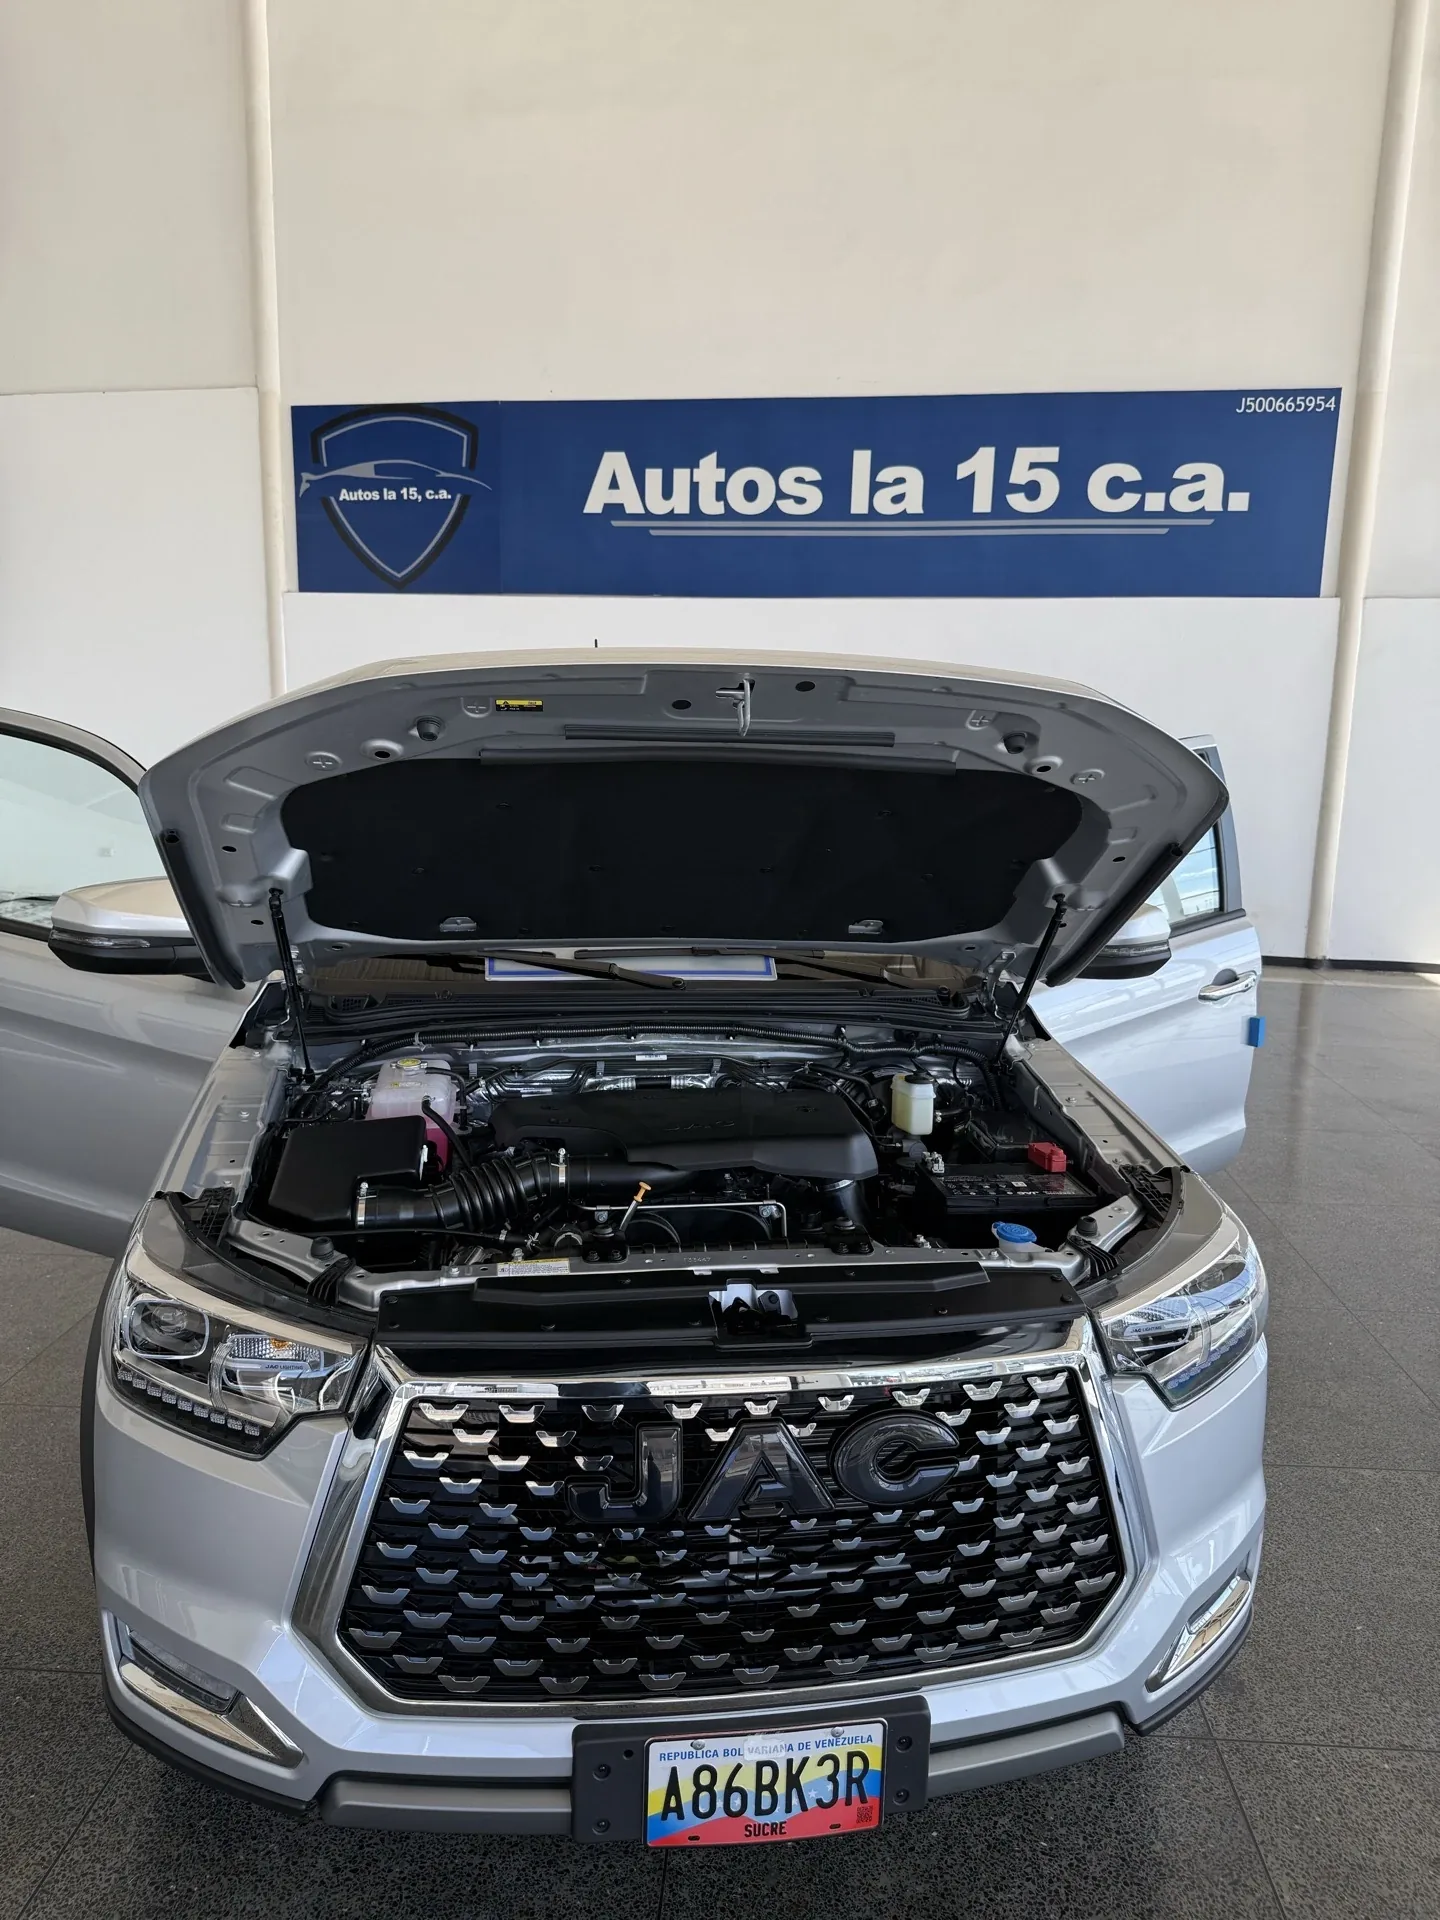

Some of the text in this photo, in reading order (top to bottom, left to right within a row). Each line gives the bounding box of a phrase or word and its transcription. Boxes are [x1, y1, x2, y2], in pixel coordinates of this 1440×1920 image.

[1235, 396, 1336, 413] J500665954
[583, 446, 1250, 515] Autos la 15 c.a.
[339, 487, 452, 502] Autos la 15, c.a.
[564, 1407, 961, 1524] JAC
[659, 1748, 719, 1762] REPUBLICA
[797, 1742, 812, 1752] DE
[815, 1735, 873, 1750] VENEZUELA
[661, 1750, 870, 1822] A86BK3R
[744, 1821, 787, 1838] SUCRE
